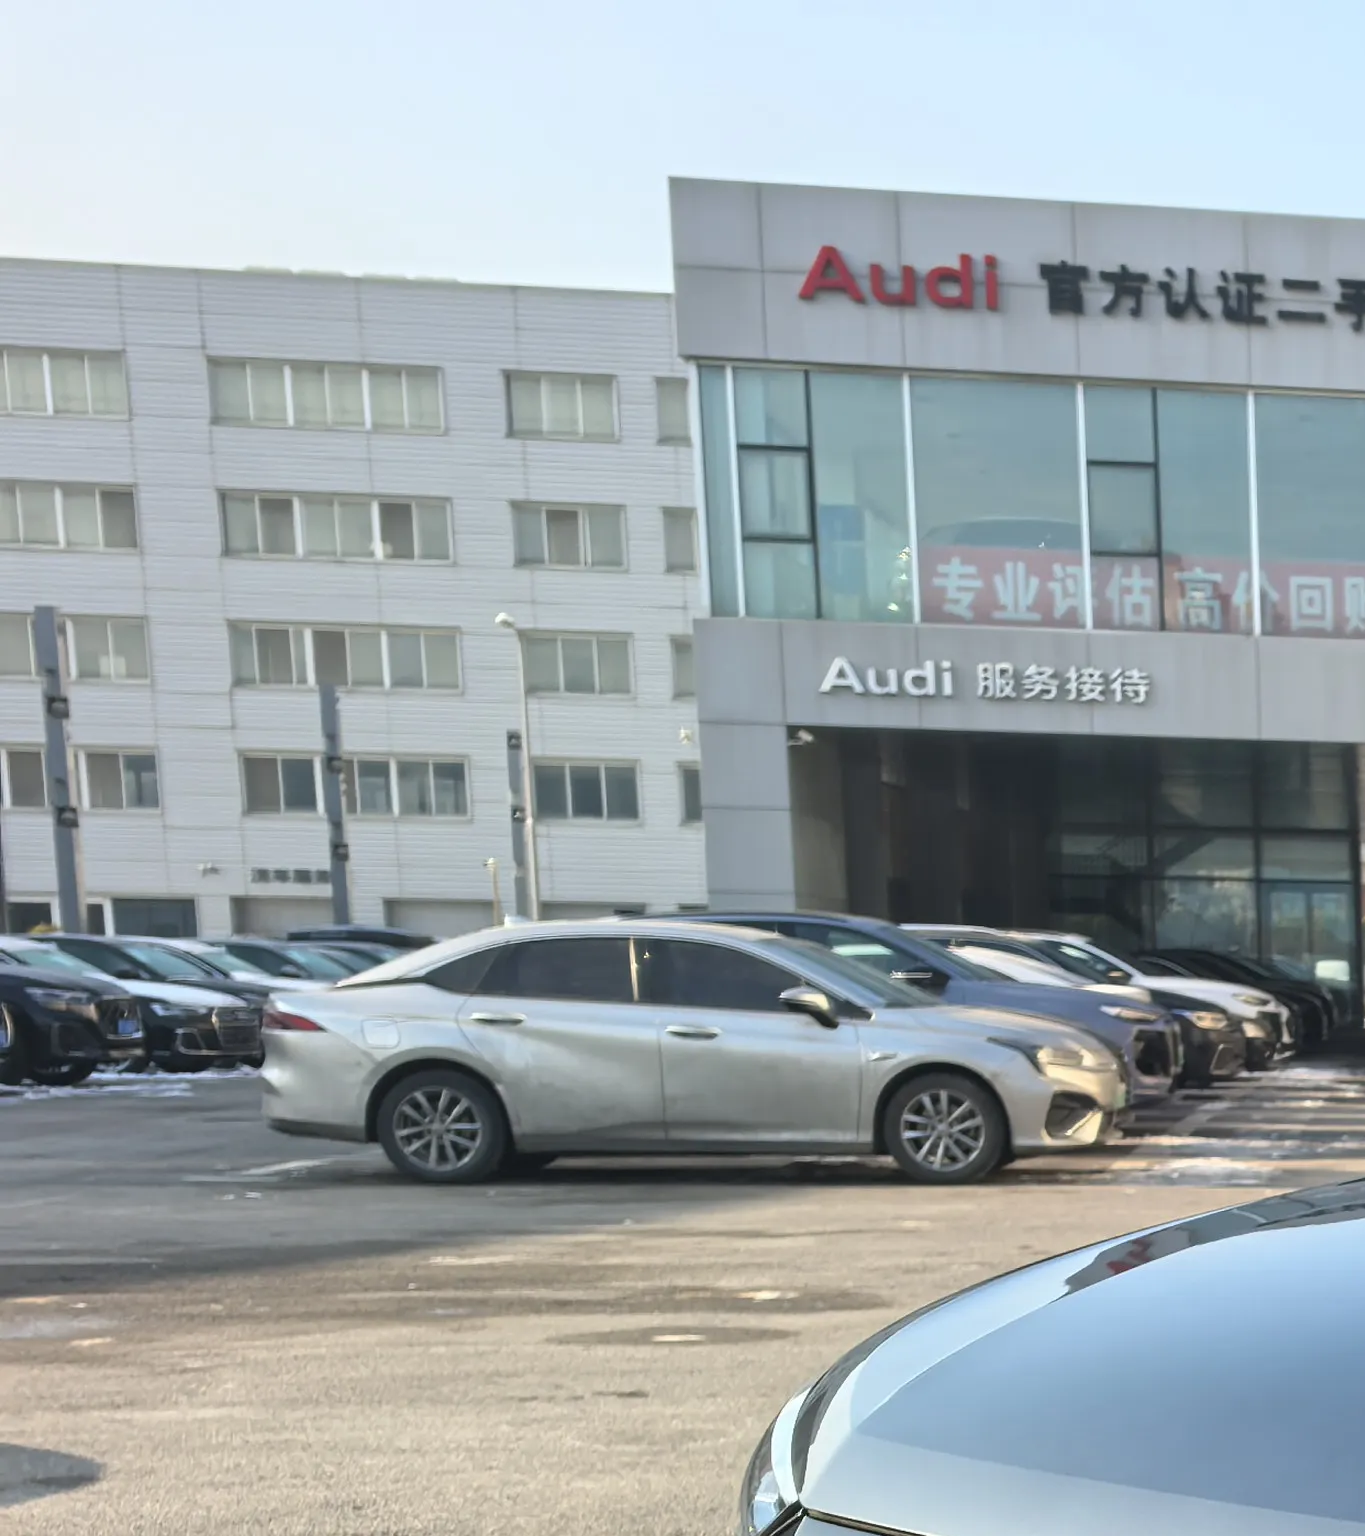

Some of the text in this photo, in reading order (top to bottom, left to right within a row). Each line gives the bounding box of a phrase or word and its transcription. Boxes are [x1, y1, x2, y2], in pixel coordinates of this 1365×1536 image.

[797, 244, 999, 311] Audi
[931, 556, 1155, 627] 专业评估
[819, 656, 953, 696] Audi
[976, 661, 1151, 704] 服务接待
